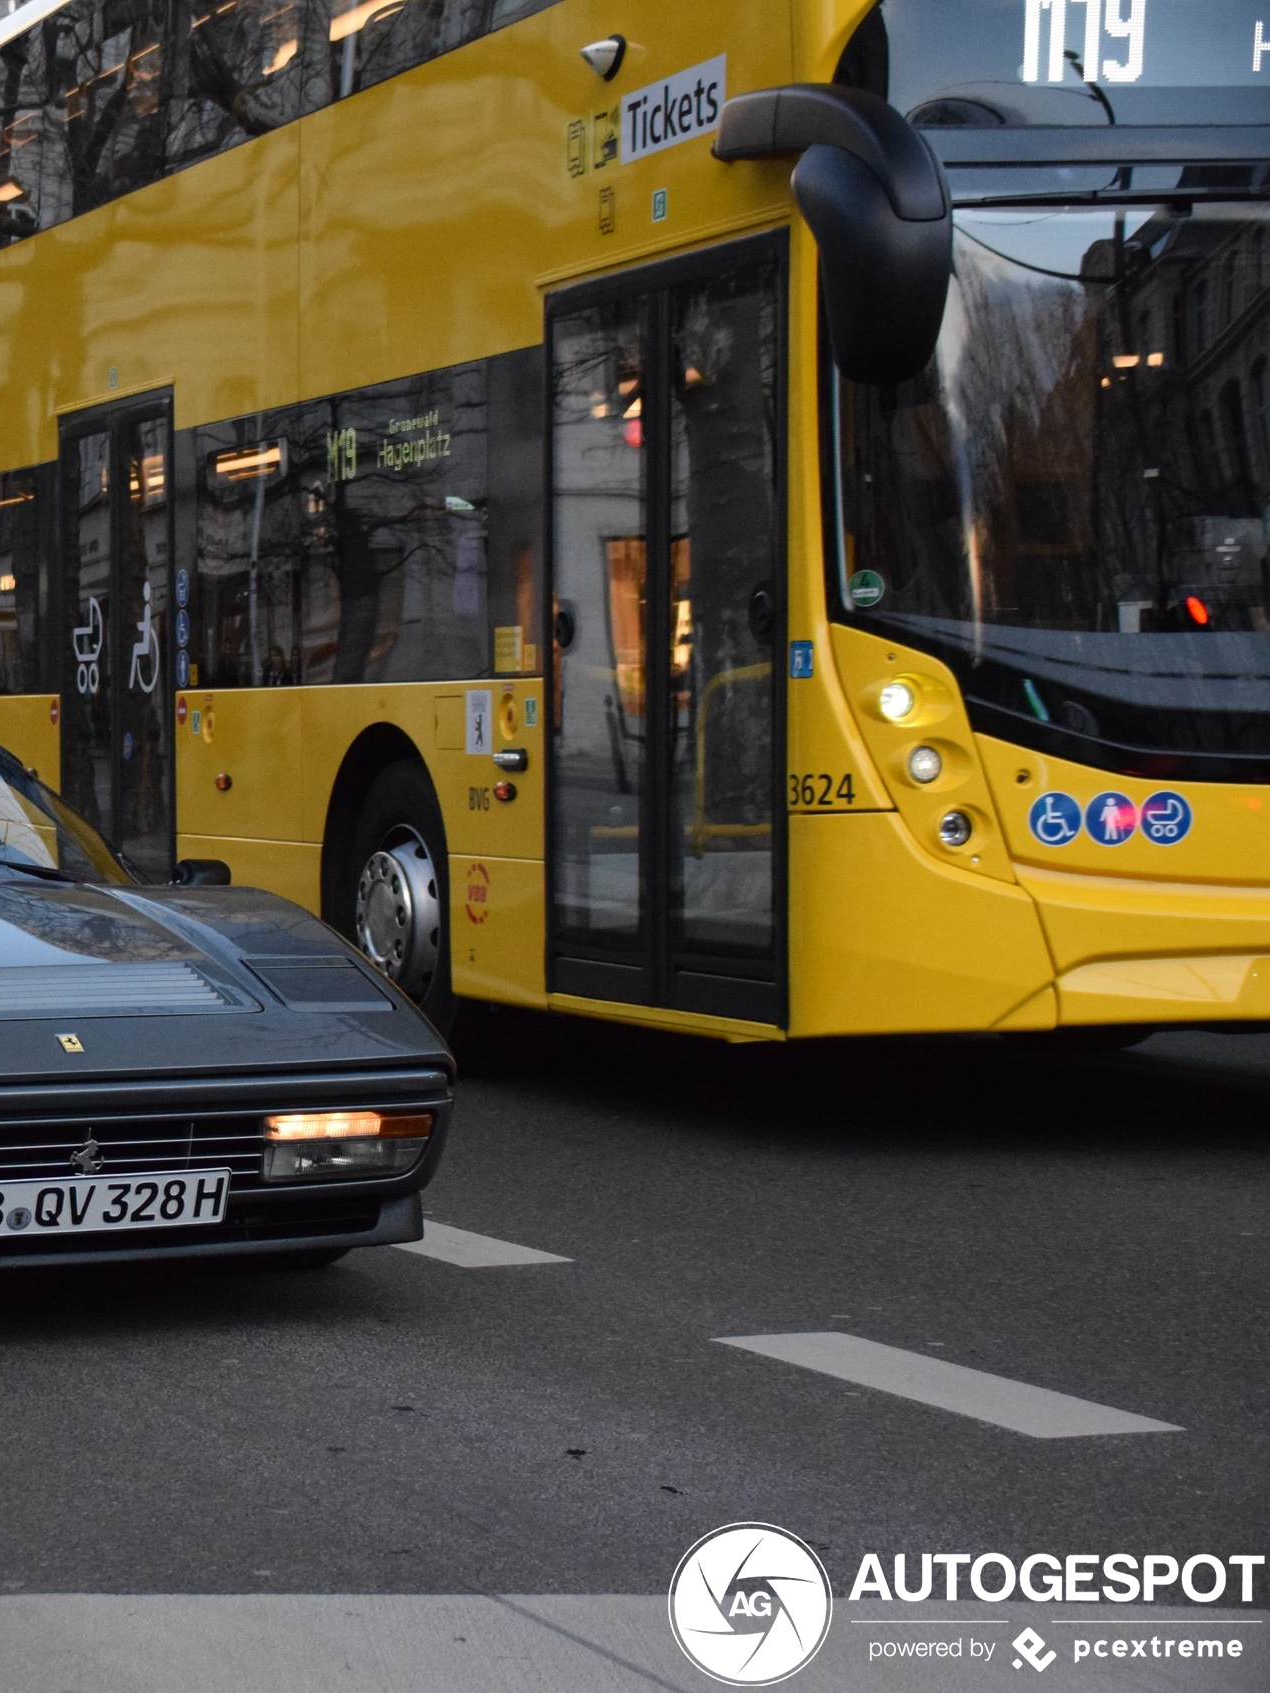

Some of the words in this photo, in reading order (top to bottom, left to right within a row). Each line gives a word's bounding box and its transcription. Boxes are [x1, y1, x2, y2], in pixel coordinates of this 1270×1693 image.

[628, 78, 718, 152] Tickets
[327, 428, 357, 482] M19
[377, 430, 451, 471] Hagenplatz
[860, 572, 870, 588] 4
[469, 786, 490, 812] BVG
[789, 773, 856, 806] 3624
[34, 1184, 97, 1227] QV
